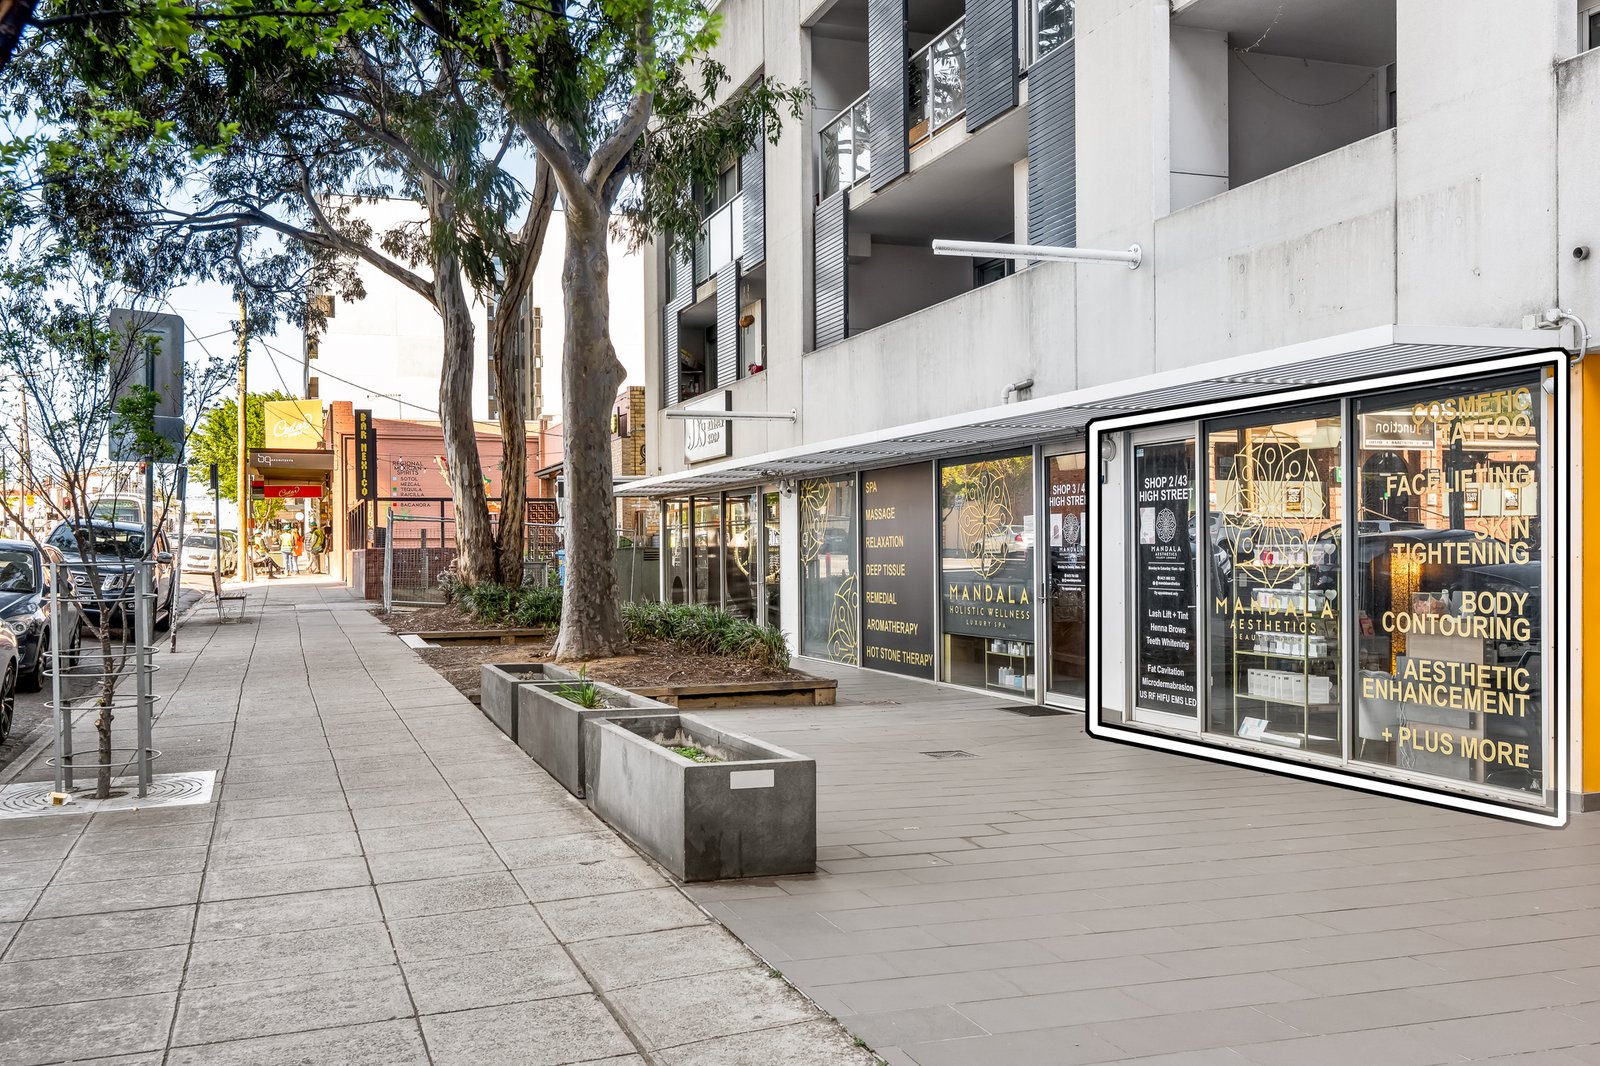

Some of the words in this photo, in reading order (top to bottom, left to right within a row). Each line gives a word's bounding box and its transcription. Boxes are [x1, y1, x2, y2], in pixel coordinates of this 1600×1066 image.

[1412, 387, 1530, 424] COSMETIC
[1442, 413, 1530, 445] TATTOO
[865, 481, 878, 494] SPA
[1052, 484, 1071, 495] SHOP
[1144, 477, 1167, 489] SHOP
[1050, 496, 1065, 507] HIGH
[1140, 490, 1159, 502] HIGH
[1160, 487, 1193, 501] STREET
[865, 507, 896, 521] MASSAGE
[1474, 516, 1530, 540] SKIN
[865, 535, 904, 549] RELAXATION
[1393, 541, 1530, 565] TIGHTENING
[865, 564, 882, 576] DEEP
[883, 563, 906, 577] TISSUE
[866, 591, 897, 605] REMEDIAL
[949, 583, 1030, 605] MANDALA
[1215, 596, 1334, 619] MANDALA
[1461, 591, 1530, 616] BODY
[949, 605, 985, 616] HOLISTIC
[987, 607, 1030, 620] WELLNESS
[1148, 609, 1161, 618] Lash
[1162, 610, 1172, 619] Lift
[1177, 611, 1189, 620] Tint
[867, 618, 919, 636] AROMATHERAPY
[966, 619, 992, 627] LUXURY
[1150, 623, 1167, 633] Henna
[1168, 624, 1186, 634] Brows
[1230, 618, 1317, 634] AESTHETICS
[1382, 611, 1531, 642] CONTOURING
[1146, 636, 1161, 646] Teeth
[1161, 638, 1189, 651] Whitening
[866, 646, 880, 658] HOT
[880, 647, 901, 663] STONE
[902, 651, 934, 666] THERAPY
[1147, 664, 1157, 673] Fat
[1157, 665, 1185, 677] Cavitation
[1403, 658, 1530, 692] AESTHETIC
[1142, 676, 1194, 692] Microdermabrasion
[1139, 690, 1148, 698] US
[1148, 691, 1156, 700] RF
[1156, 693, 1170, 703] HIFU
[1171, 695, 1184, 704] EMS
[1184, 697, 1197, 707] LED
[1362, 678, 1531, 718] ENHANCEMENT
[1381, 727, 1393, 743] +
[1399, 726, 1454, 756] PLUS
[1460, 735, 1530, 769] MORE
